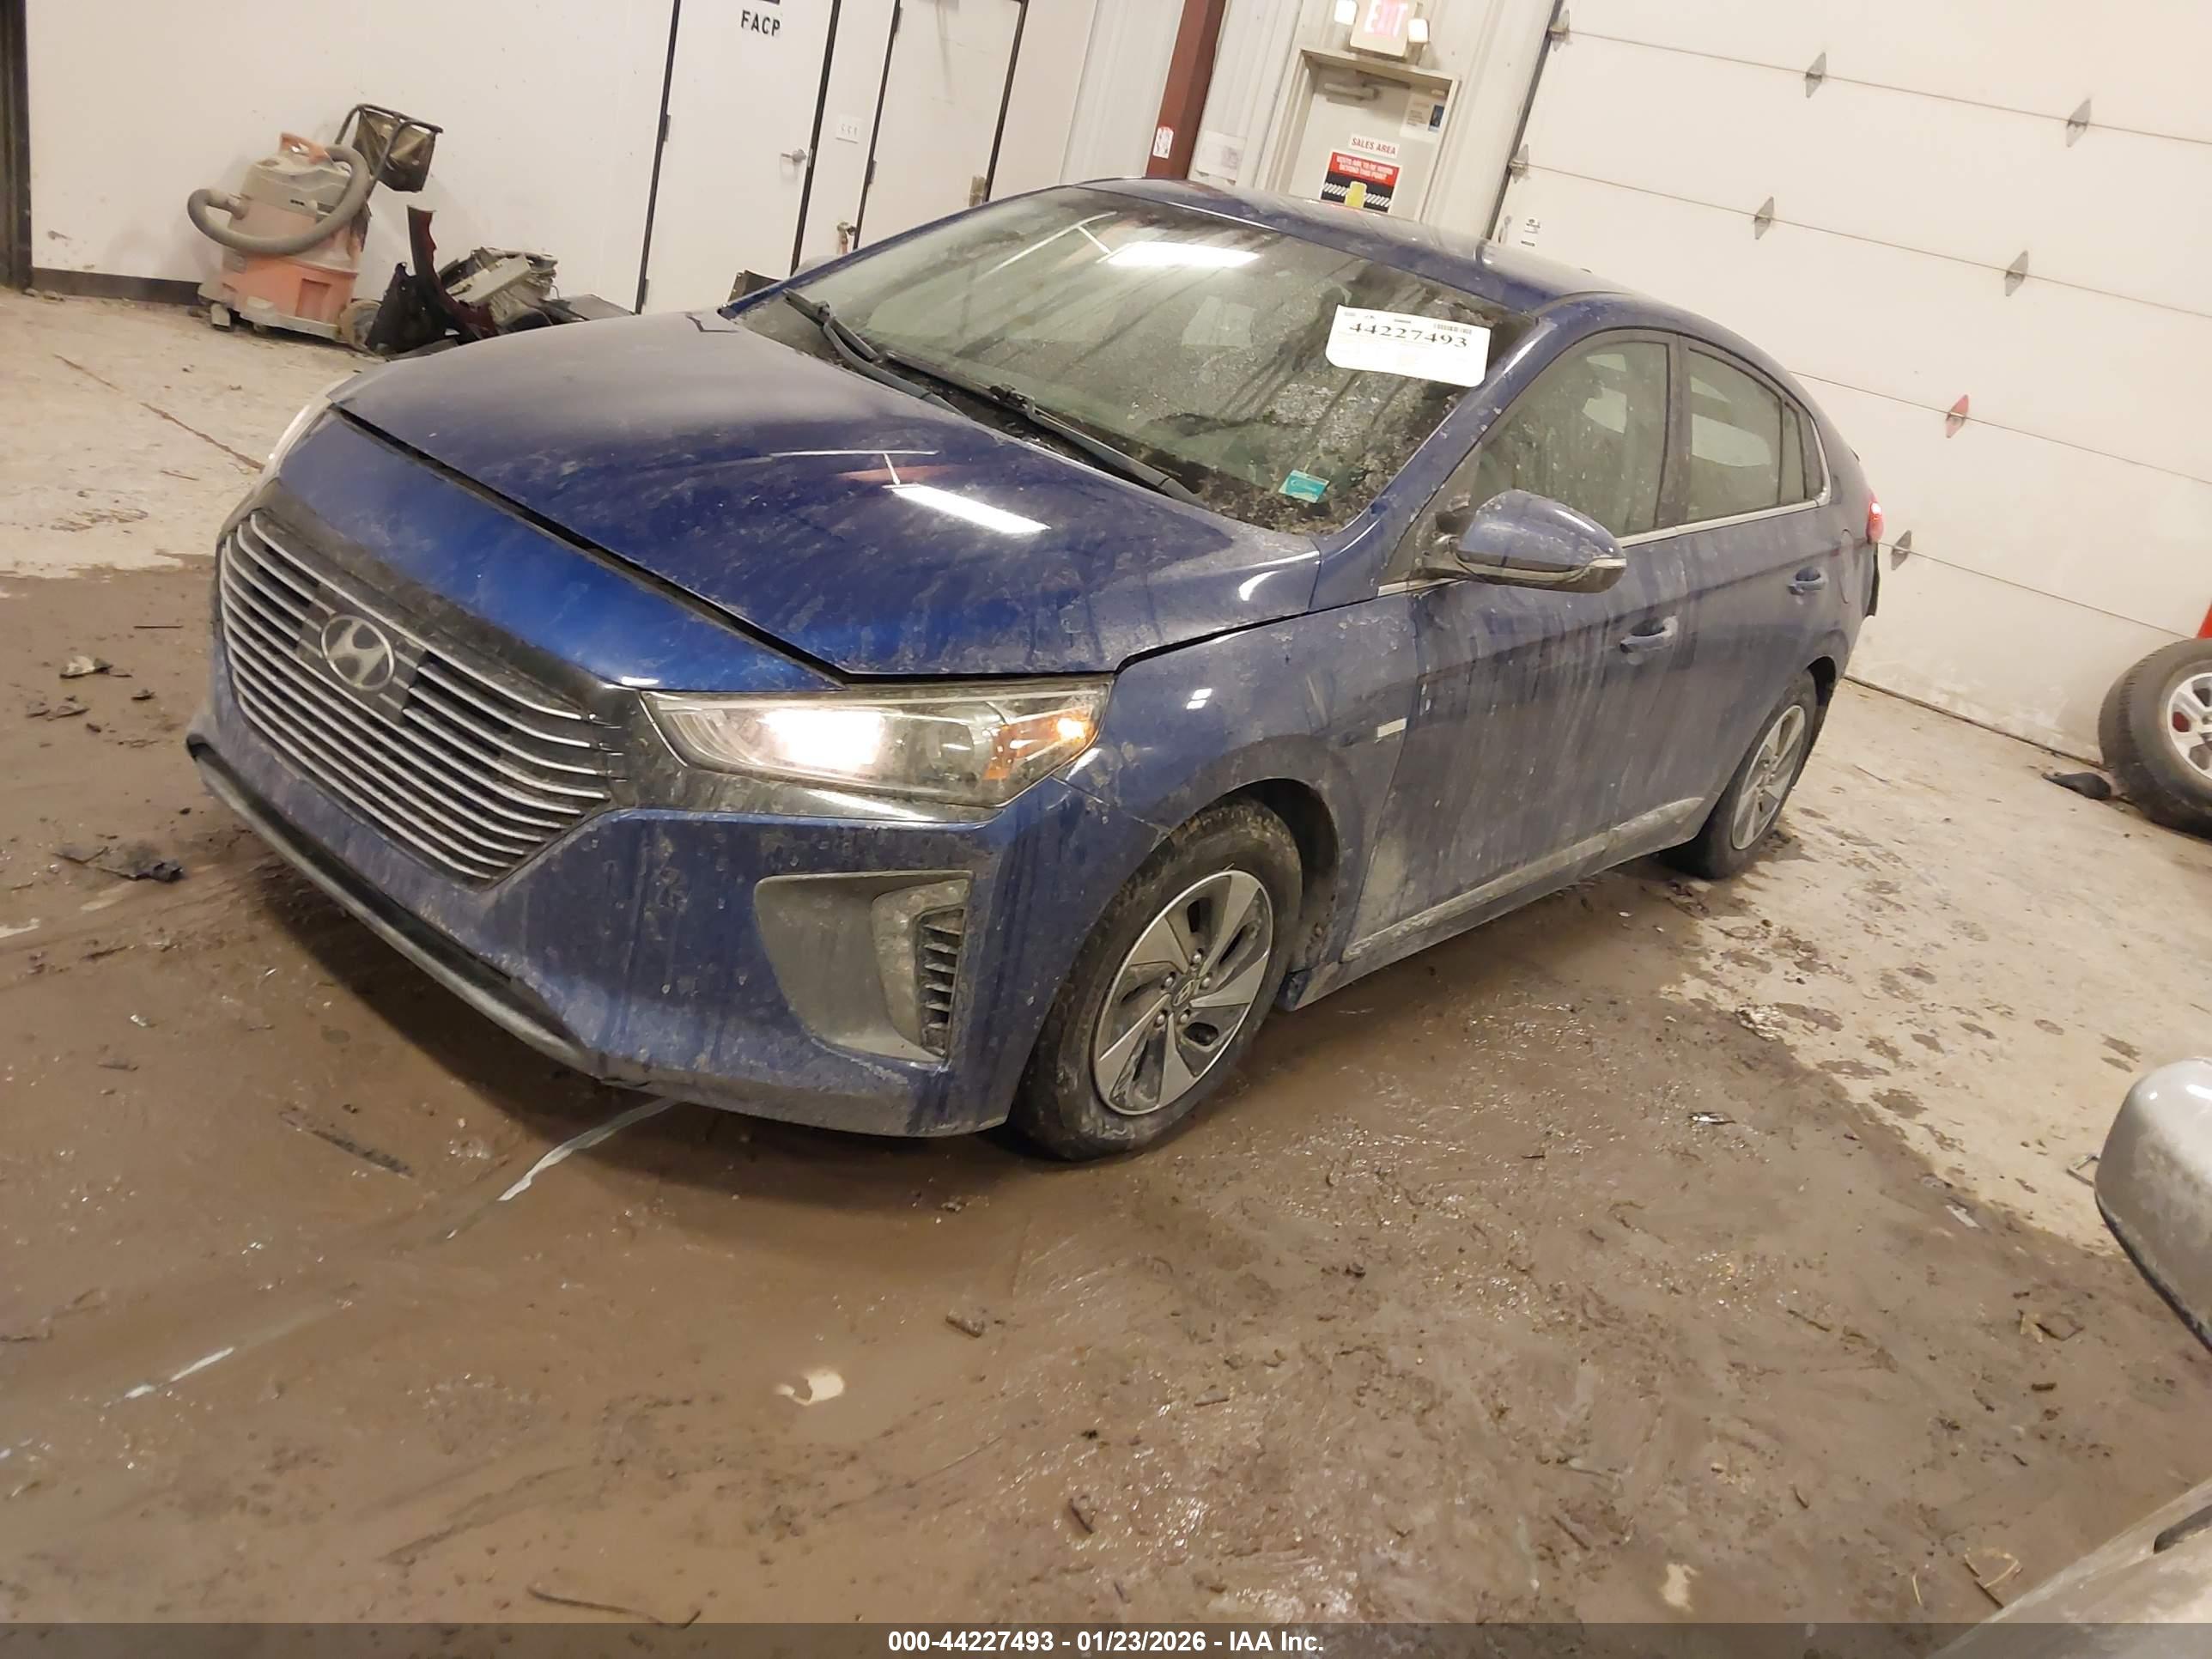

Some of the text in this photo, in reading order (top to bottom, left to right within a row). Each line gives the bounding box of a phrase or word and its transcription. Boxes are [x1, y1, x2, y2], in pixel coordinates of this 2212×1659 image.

[740, 9, 781, 37] FACP
[1364, 0, 1407, 37] EXIT
[1351, 137, 1396, 155] SALES AREA
[1349, 321, 1468, 349] 44227493
